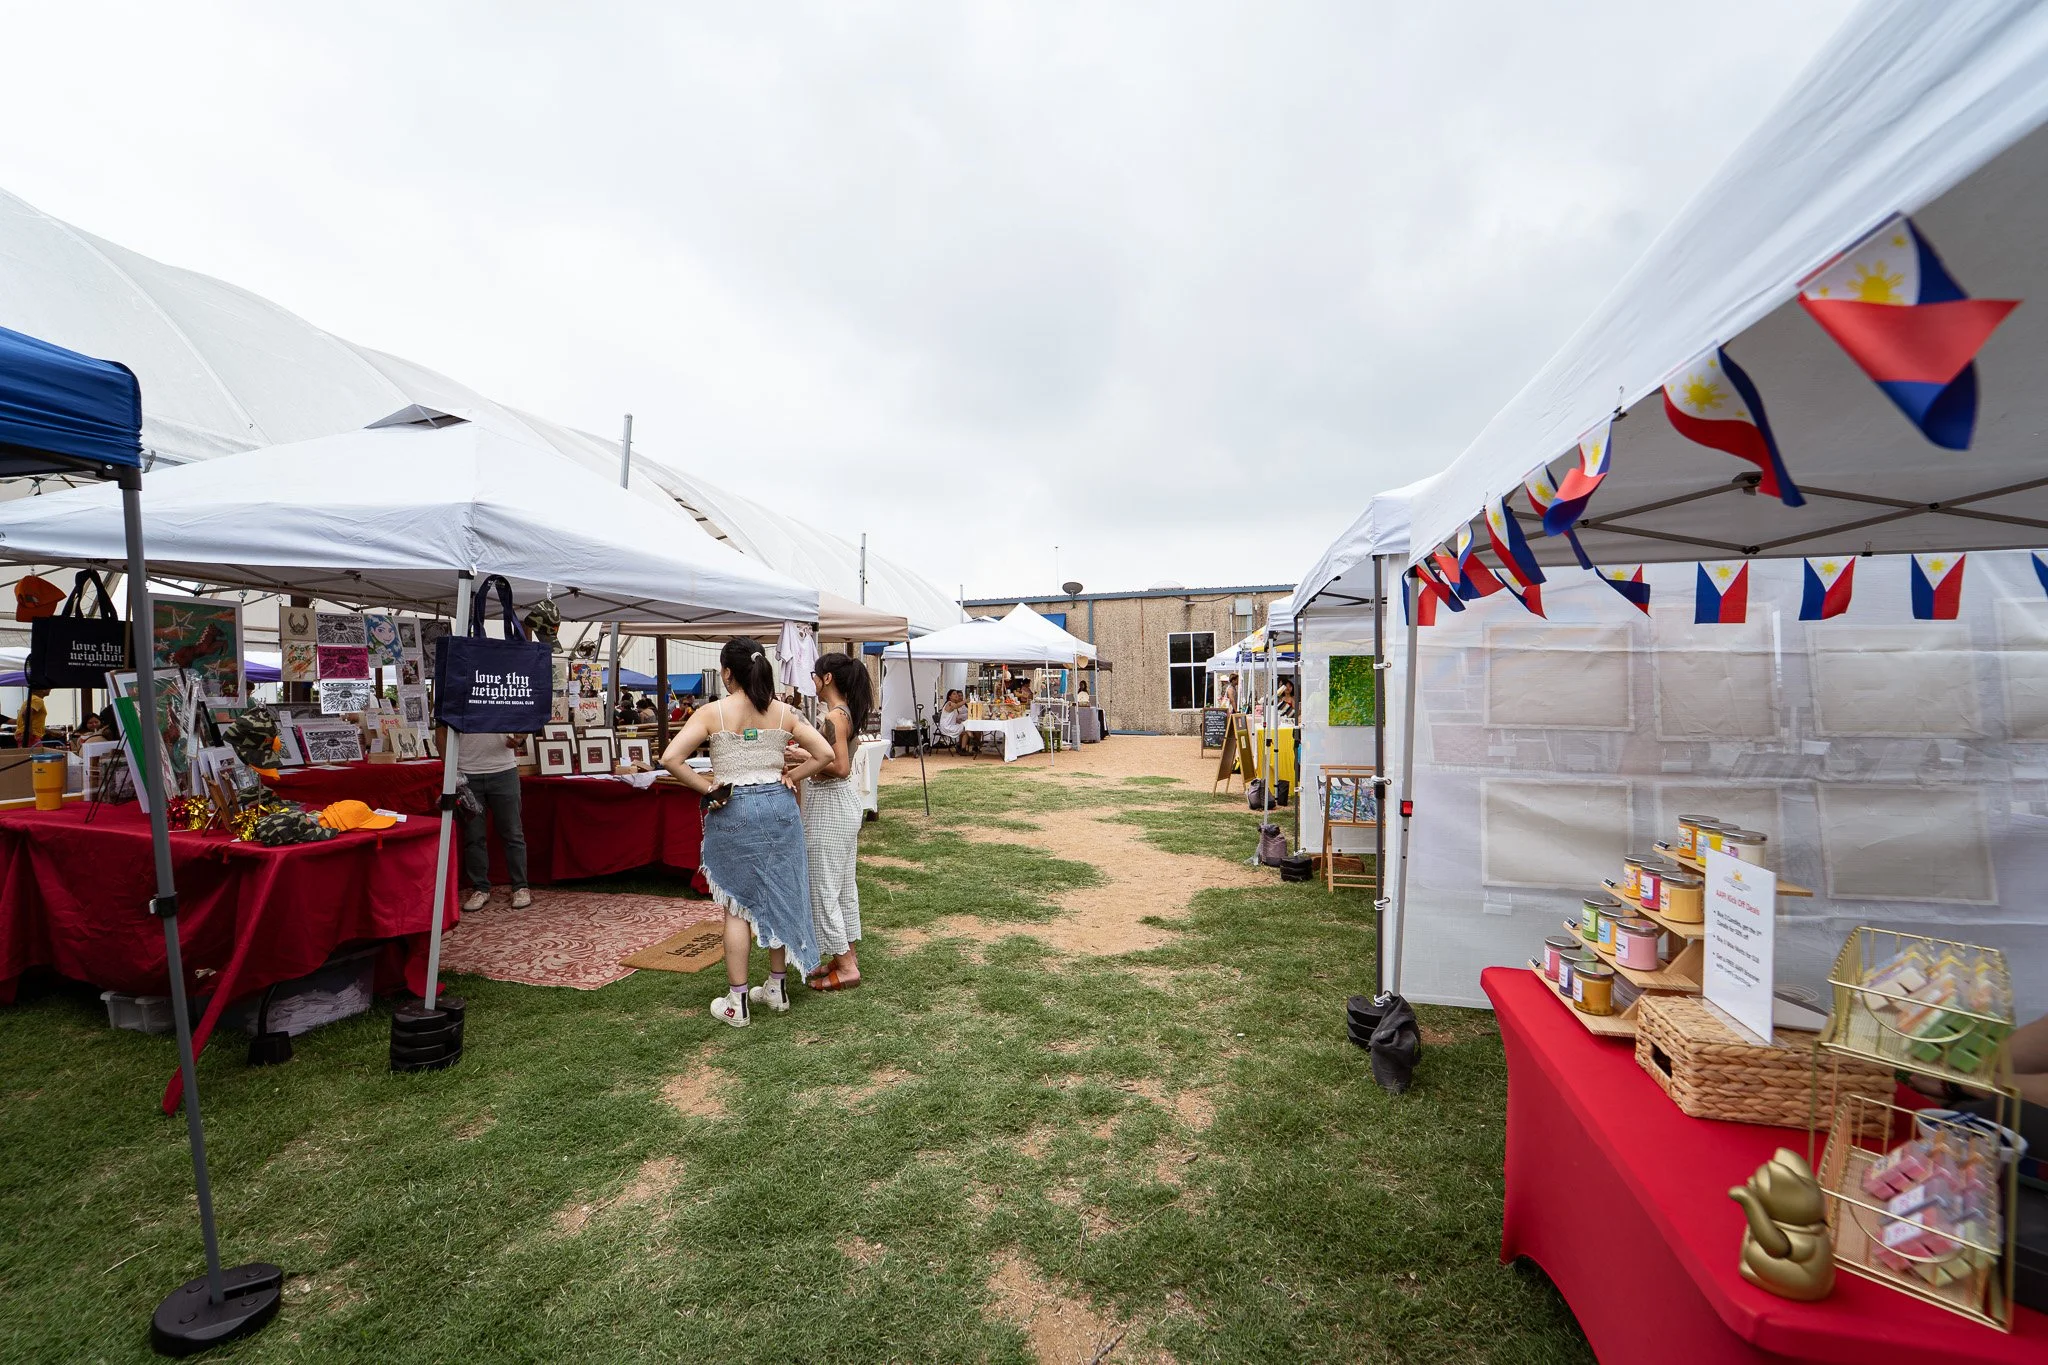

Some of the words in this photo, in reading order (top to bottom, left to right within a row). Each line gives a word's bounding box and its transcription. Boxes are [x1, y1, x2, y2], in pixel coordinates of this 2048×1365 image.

[72, 640, 97, 651] love
[101, 642, 122, 654] thy
[70, 651, 124, 663] neighbor
[475, 670, 501, 684] love
[506, 672, 529, 688] thy
[471, 684, 533, 700] neighbor
